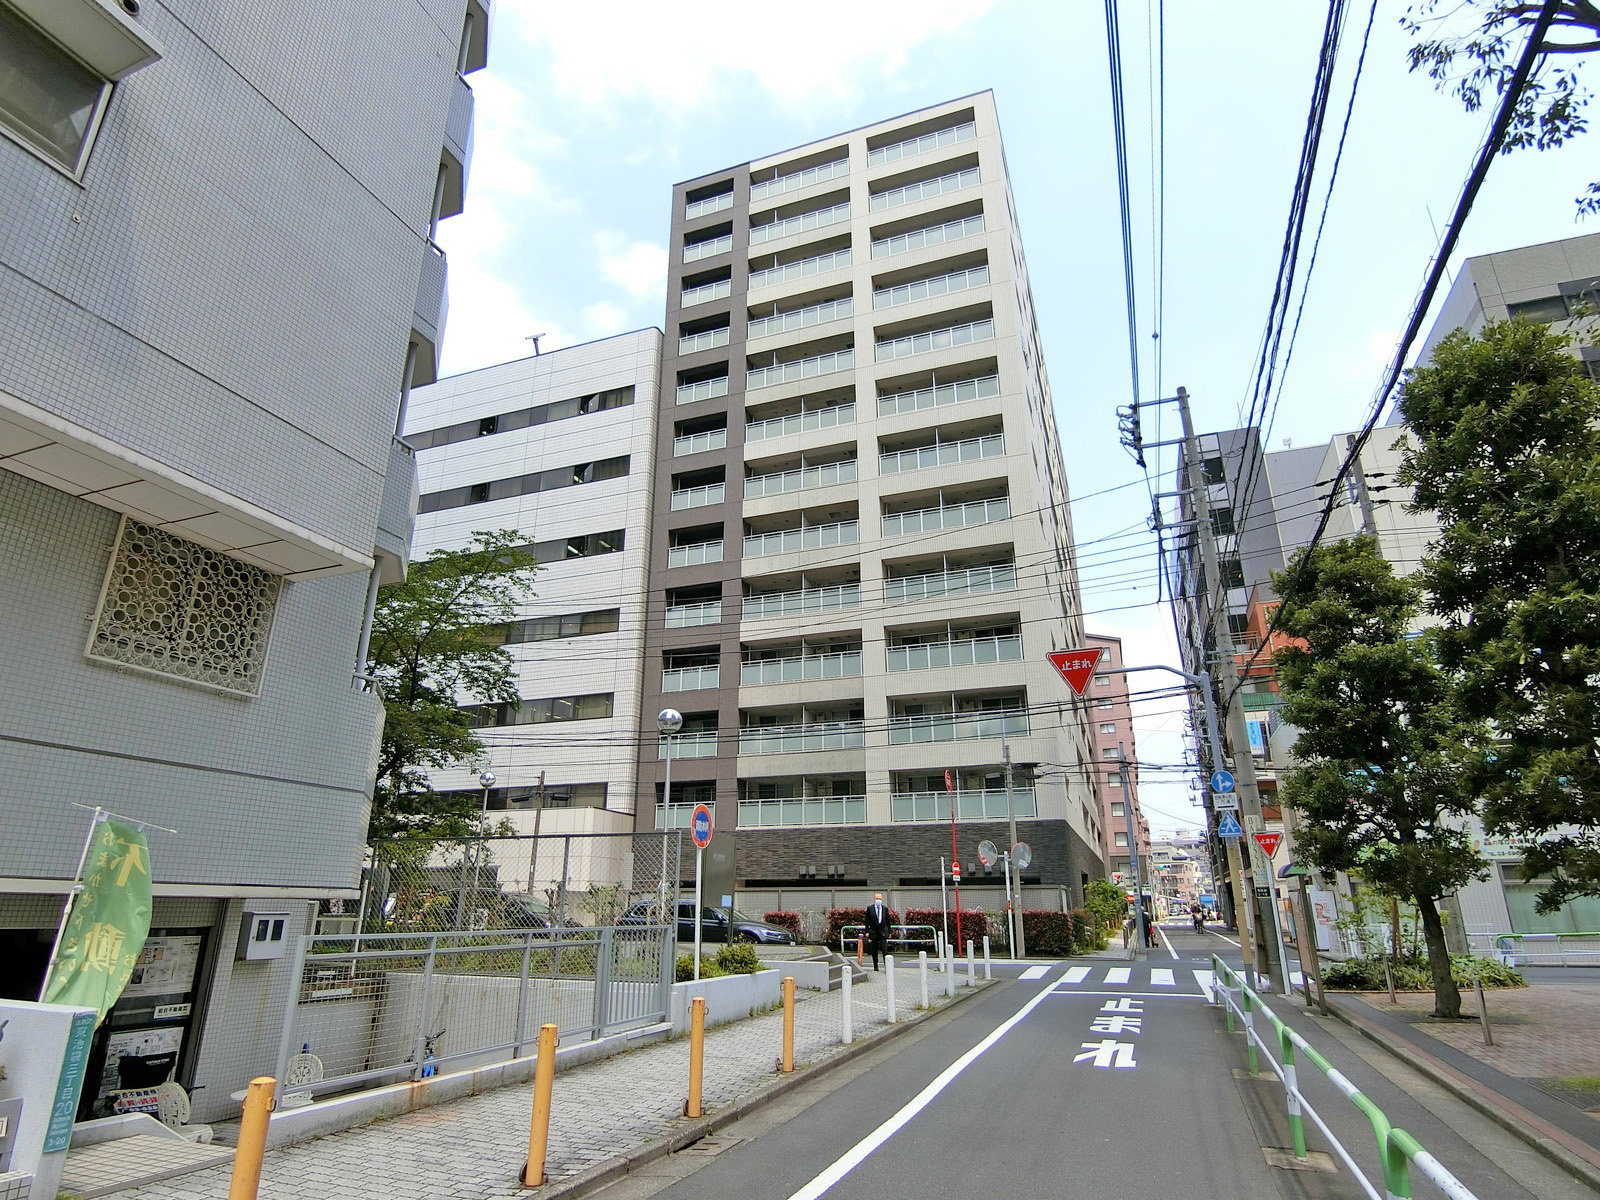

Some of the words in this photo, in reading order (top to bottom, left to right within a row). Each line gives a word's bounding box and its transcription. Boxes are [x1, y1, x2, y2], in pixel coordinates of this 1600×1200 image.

[1061, 658, 1093, 671] 止まれ
[1247, 816, 1261, 869] BAOSSA
[1073, 997, 1144, 1068] 止まれ
[55, 1102, 73, 1116] 20
[48, 1136, 66, 1147] 3-20
